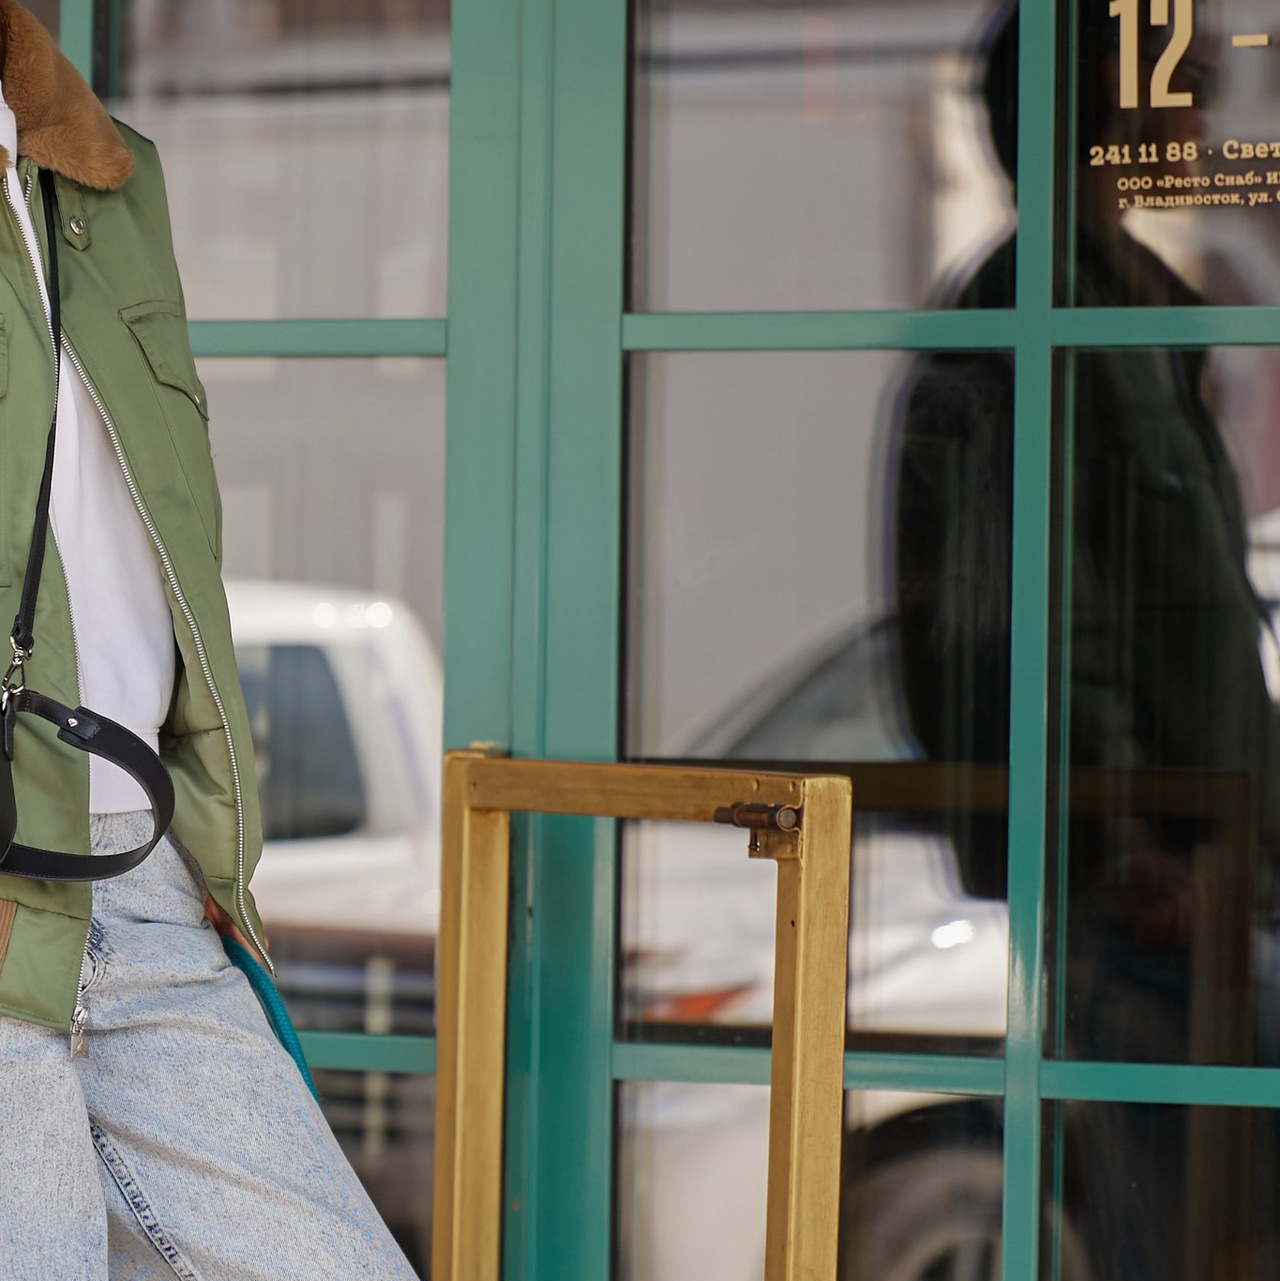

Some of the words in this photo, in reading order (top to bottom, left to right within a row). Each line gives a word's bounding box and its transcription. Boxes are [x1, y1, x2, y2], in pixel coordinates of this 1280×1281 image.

[1089, 144, 1132, 166] 241
[1138, 142, 1160, 164] 11
[1165, 141, 1198, 162] 88
[1117, 176, 1153, 191] ООО
[1156, 175, 1211, 189] «Ресто
[1214, 169, 1263, 187] Снаб»
[1134, 193, 1245, 208] Владивосток,
[1248, 192, 1273, 207] ул.
